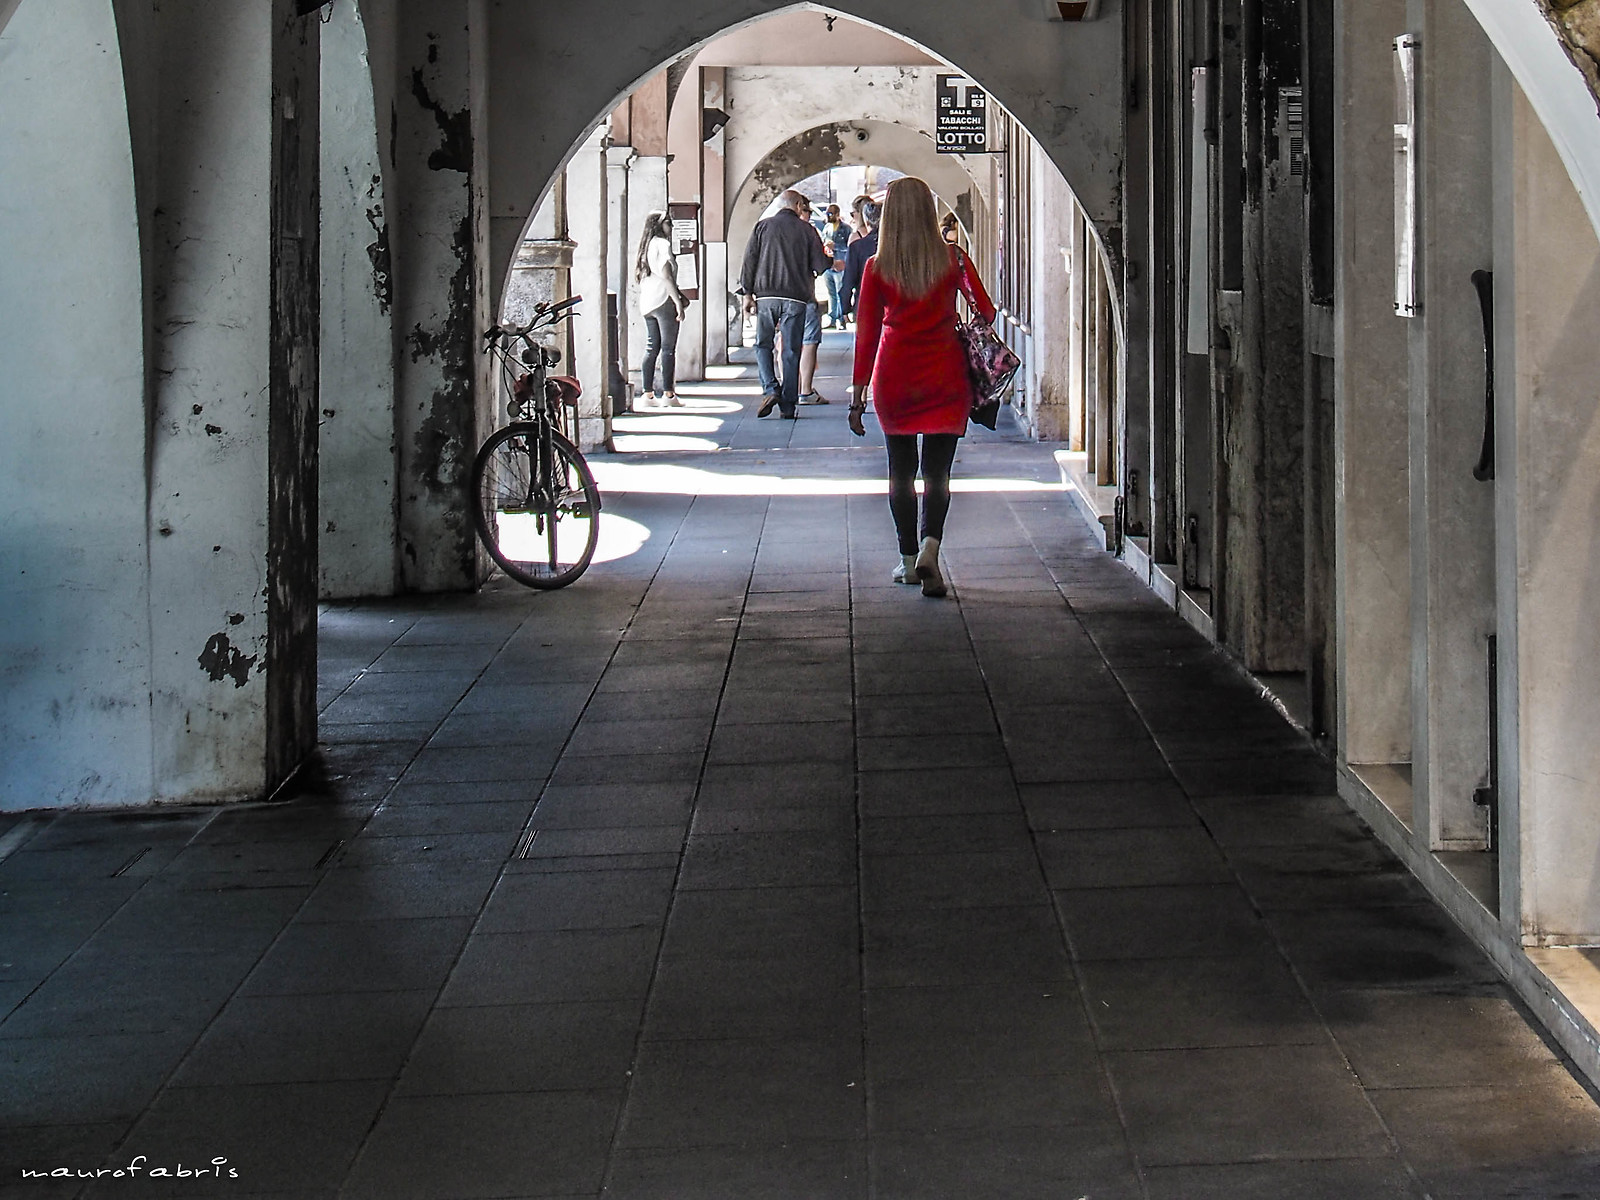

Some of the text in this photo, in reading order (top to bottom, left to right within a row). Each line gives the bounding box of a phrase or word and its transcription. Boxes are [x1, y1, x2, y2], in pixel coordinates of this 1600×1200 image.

[946, 78, 978, 108] T
[940, 116, 981, 125] TABACCHI
[936, 132, 985, 144] LOTTO
